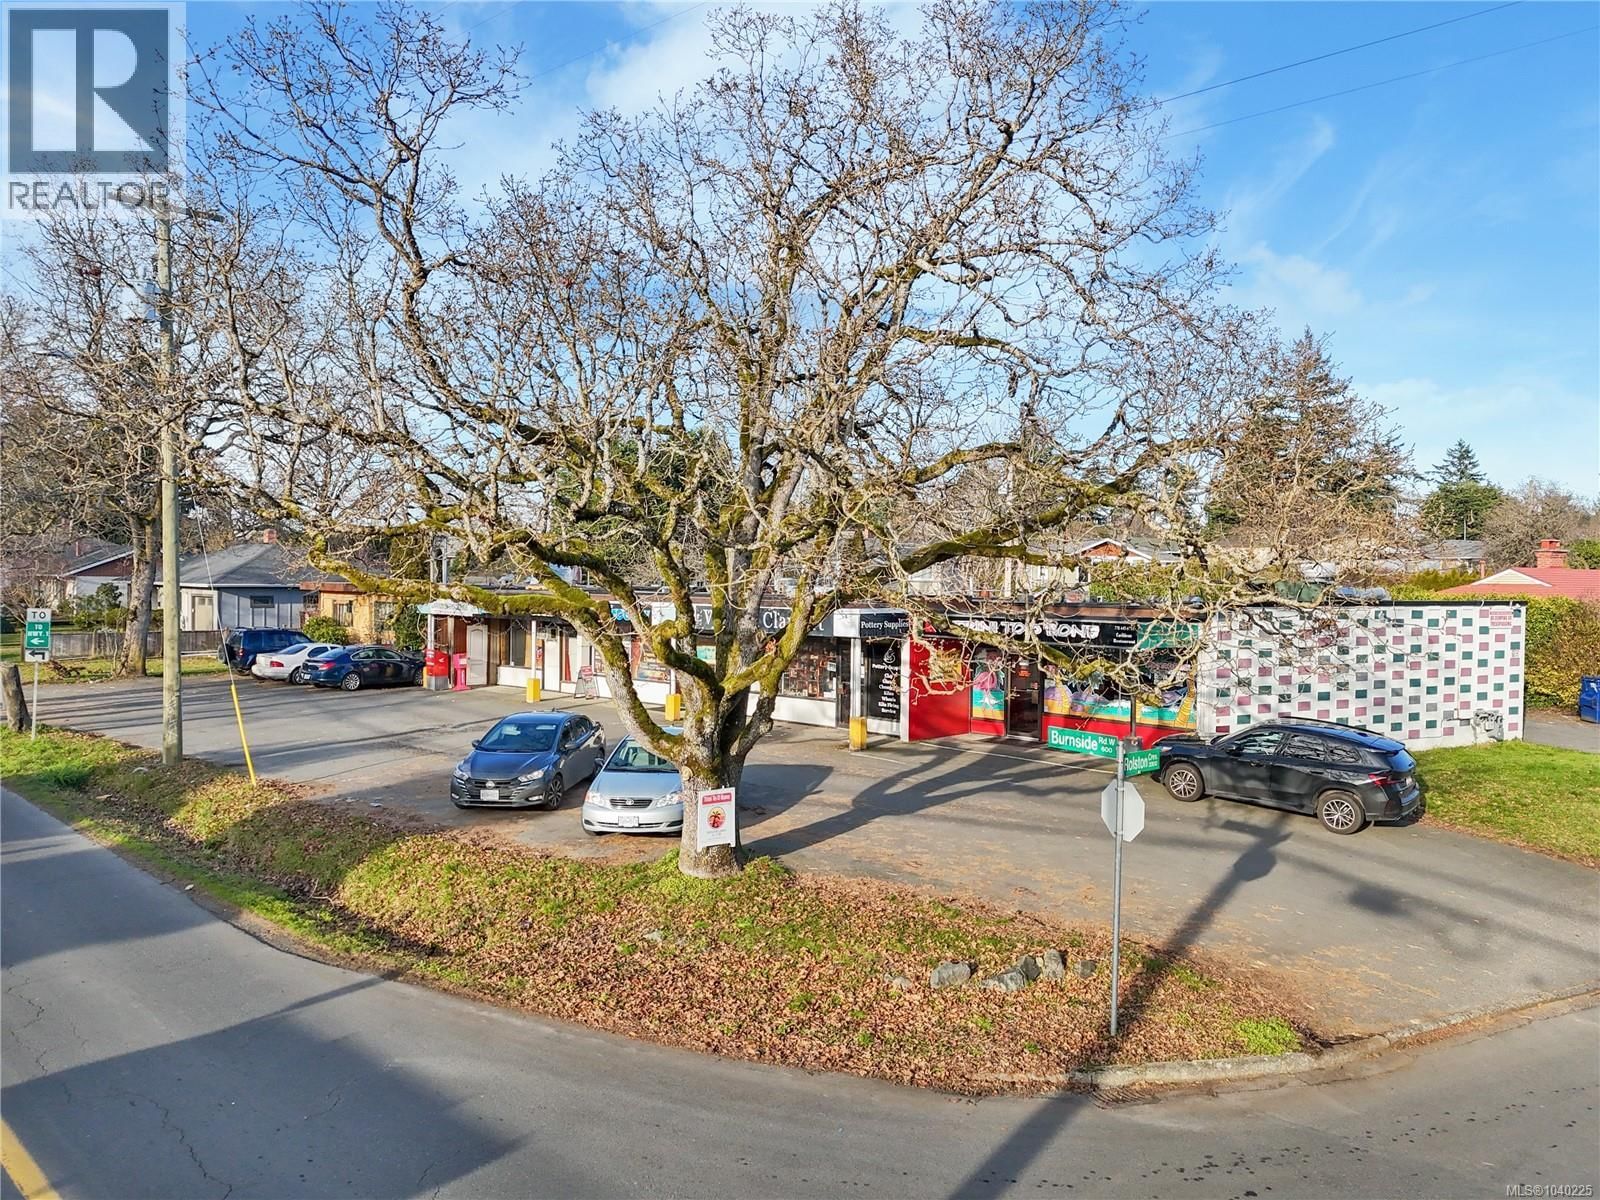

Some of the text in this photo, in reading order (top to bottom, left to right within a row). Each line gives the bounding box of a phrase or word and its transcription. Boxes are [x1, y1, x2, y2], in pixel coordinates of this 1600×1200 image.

[31, 611, 47, 619] TO
[762, 611, 791, 629] Cla
[860, 620, 908, 630] Pottery Supplies
[1051, 730, 1116, 751] Burnside Rd W
[1124, 755, 1148, 771] Rolston
